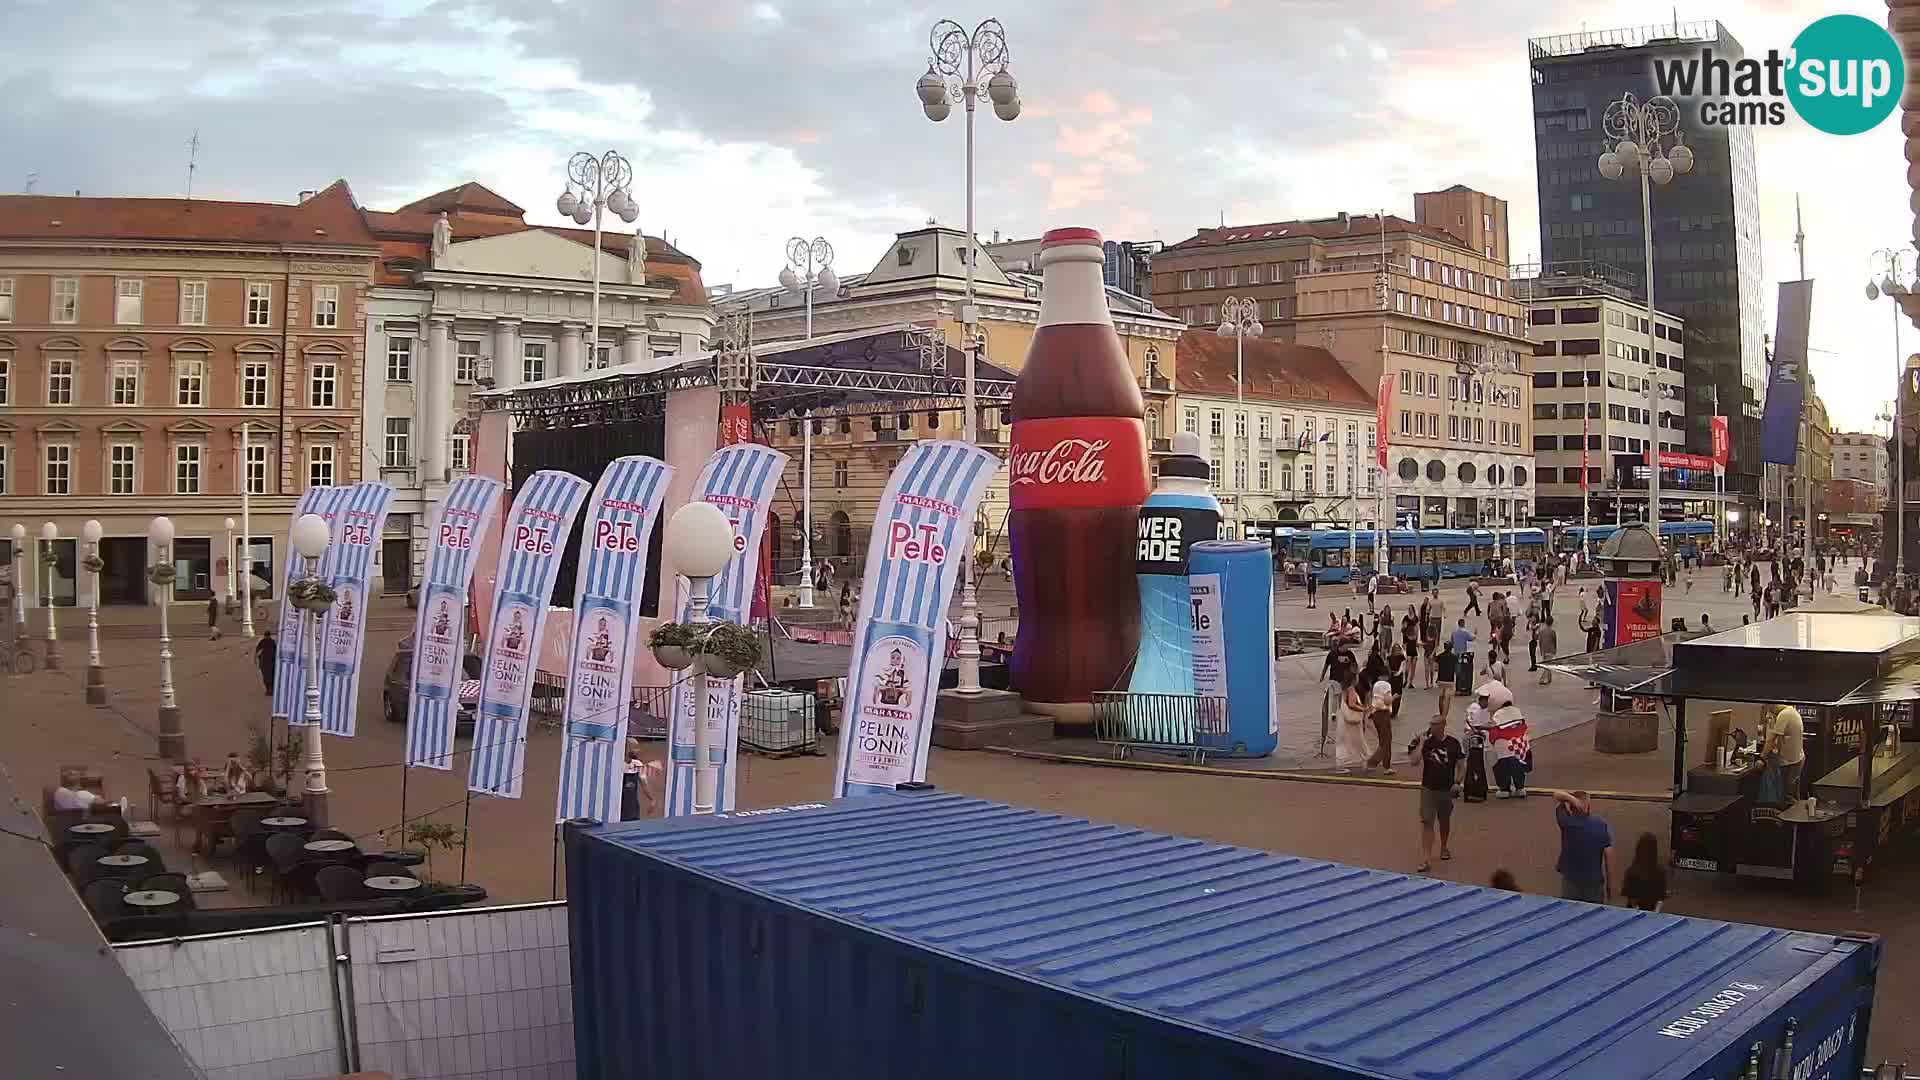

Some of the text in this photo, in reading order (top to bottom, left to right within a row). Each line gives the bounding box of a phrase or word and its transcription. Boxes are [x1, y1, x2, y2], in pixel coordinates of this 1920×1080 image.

[605, 501, 644, 513] MARASKA
[901, 494, 957, 515] MARASKA
[343, 525, 371, 546] PeTe
[440, 525, 471, 549] PeTe
[515, 526, 553, 554] PeTe
[595, 520, 638, 551] PeTe
[889, 521, 946, 565] PeTe
[1136, 540, 1182, 562] ADE
[858, 735, 908, 756] TONIK
[1657, 1013, 1708, 1040] MCDU
[1697, 988, 1747, 1021] 300629
